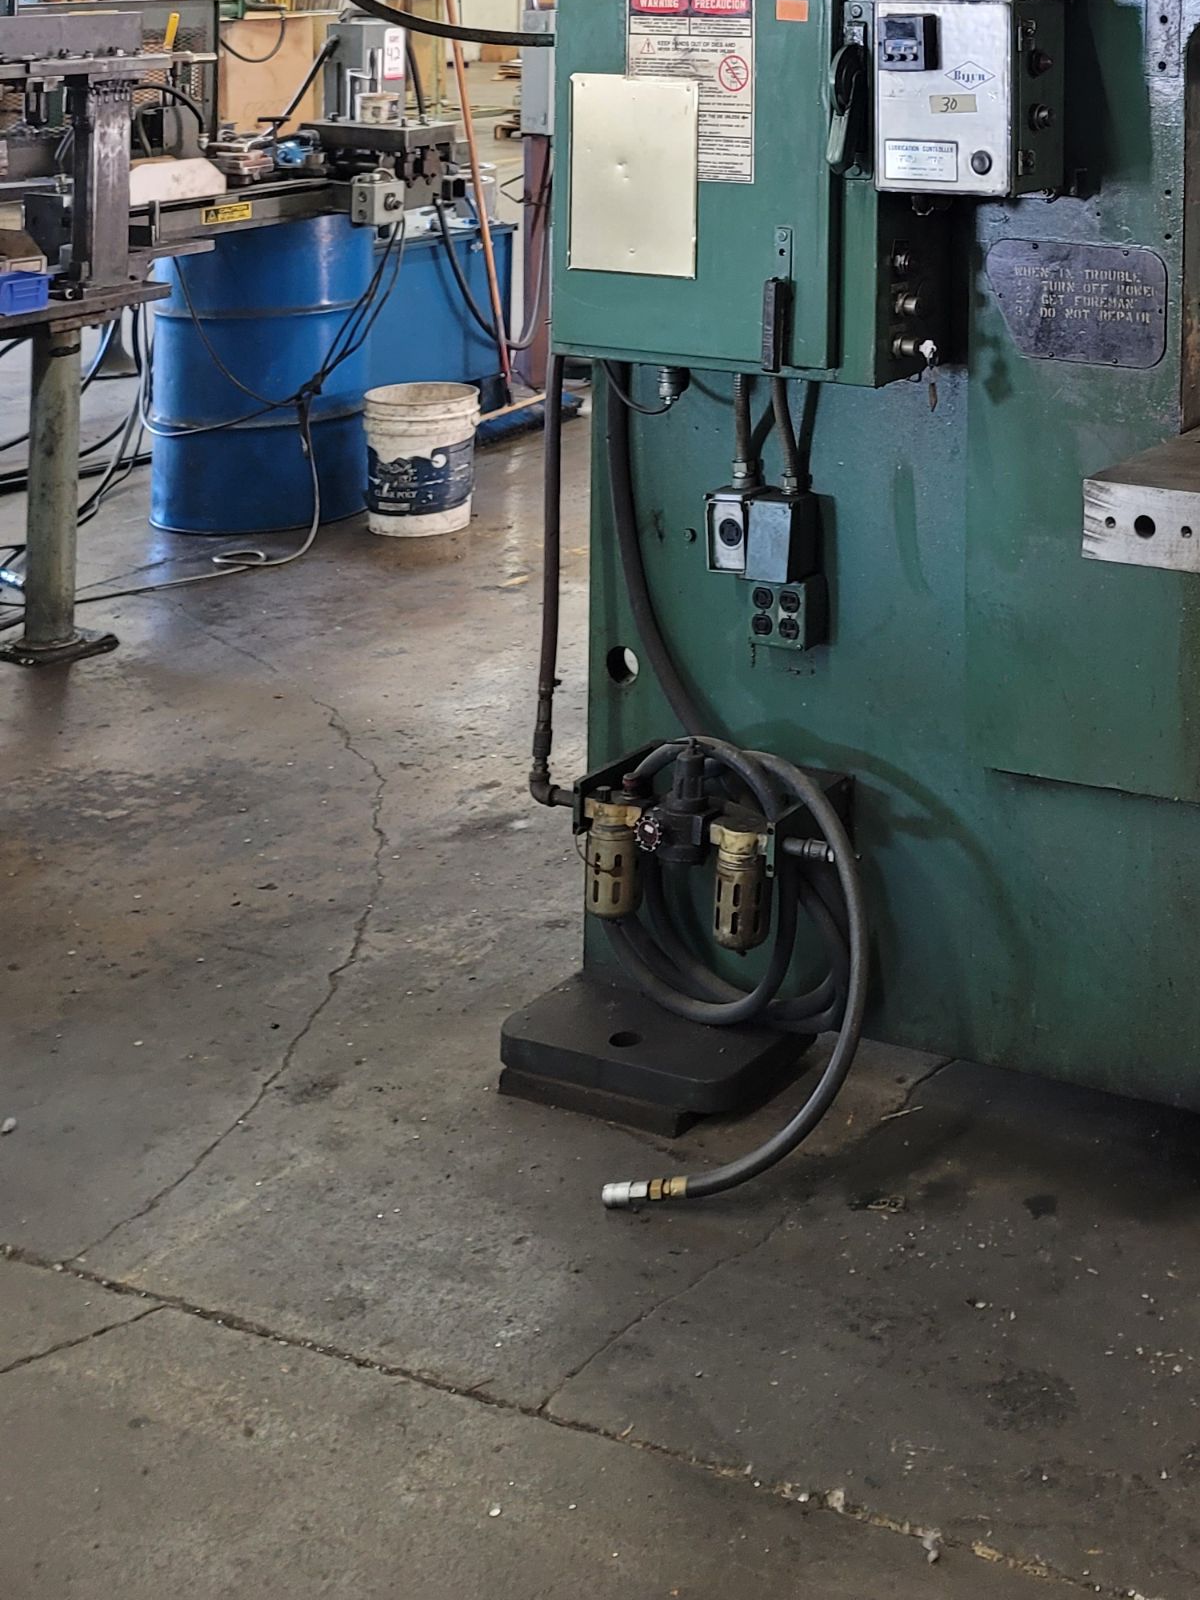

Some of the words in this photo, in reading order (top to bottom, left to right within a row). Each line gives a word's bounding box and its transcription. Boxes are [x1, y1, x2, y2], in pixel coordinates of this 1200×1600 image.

[694, 0, 746, 9] PRECAUCION
[940, 96, 958, 113] 30
[1014, 266, 1050, 278] WHEN
[1084, 269, 1142, 283] TROUBLE
[1041, 280, 1075, 292] TURN
[1083, 283, 1109, 295] OFF
[1041, 294, 1064, 305] GET
[1074, 296, 1138, 309] FOREMAN
[1039, 307, 1056, 318] DO
[1064, 308, 1090, 320] NOT
[1099, 311, 1151, 323] REPAIR
